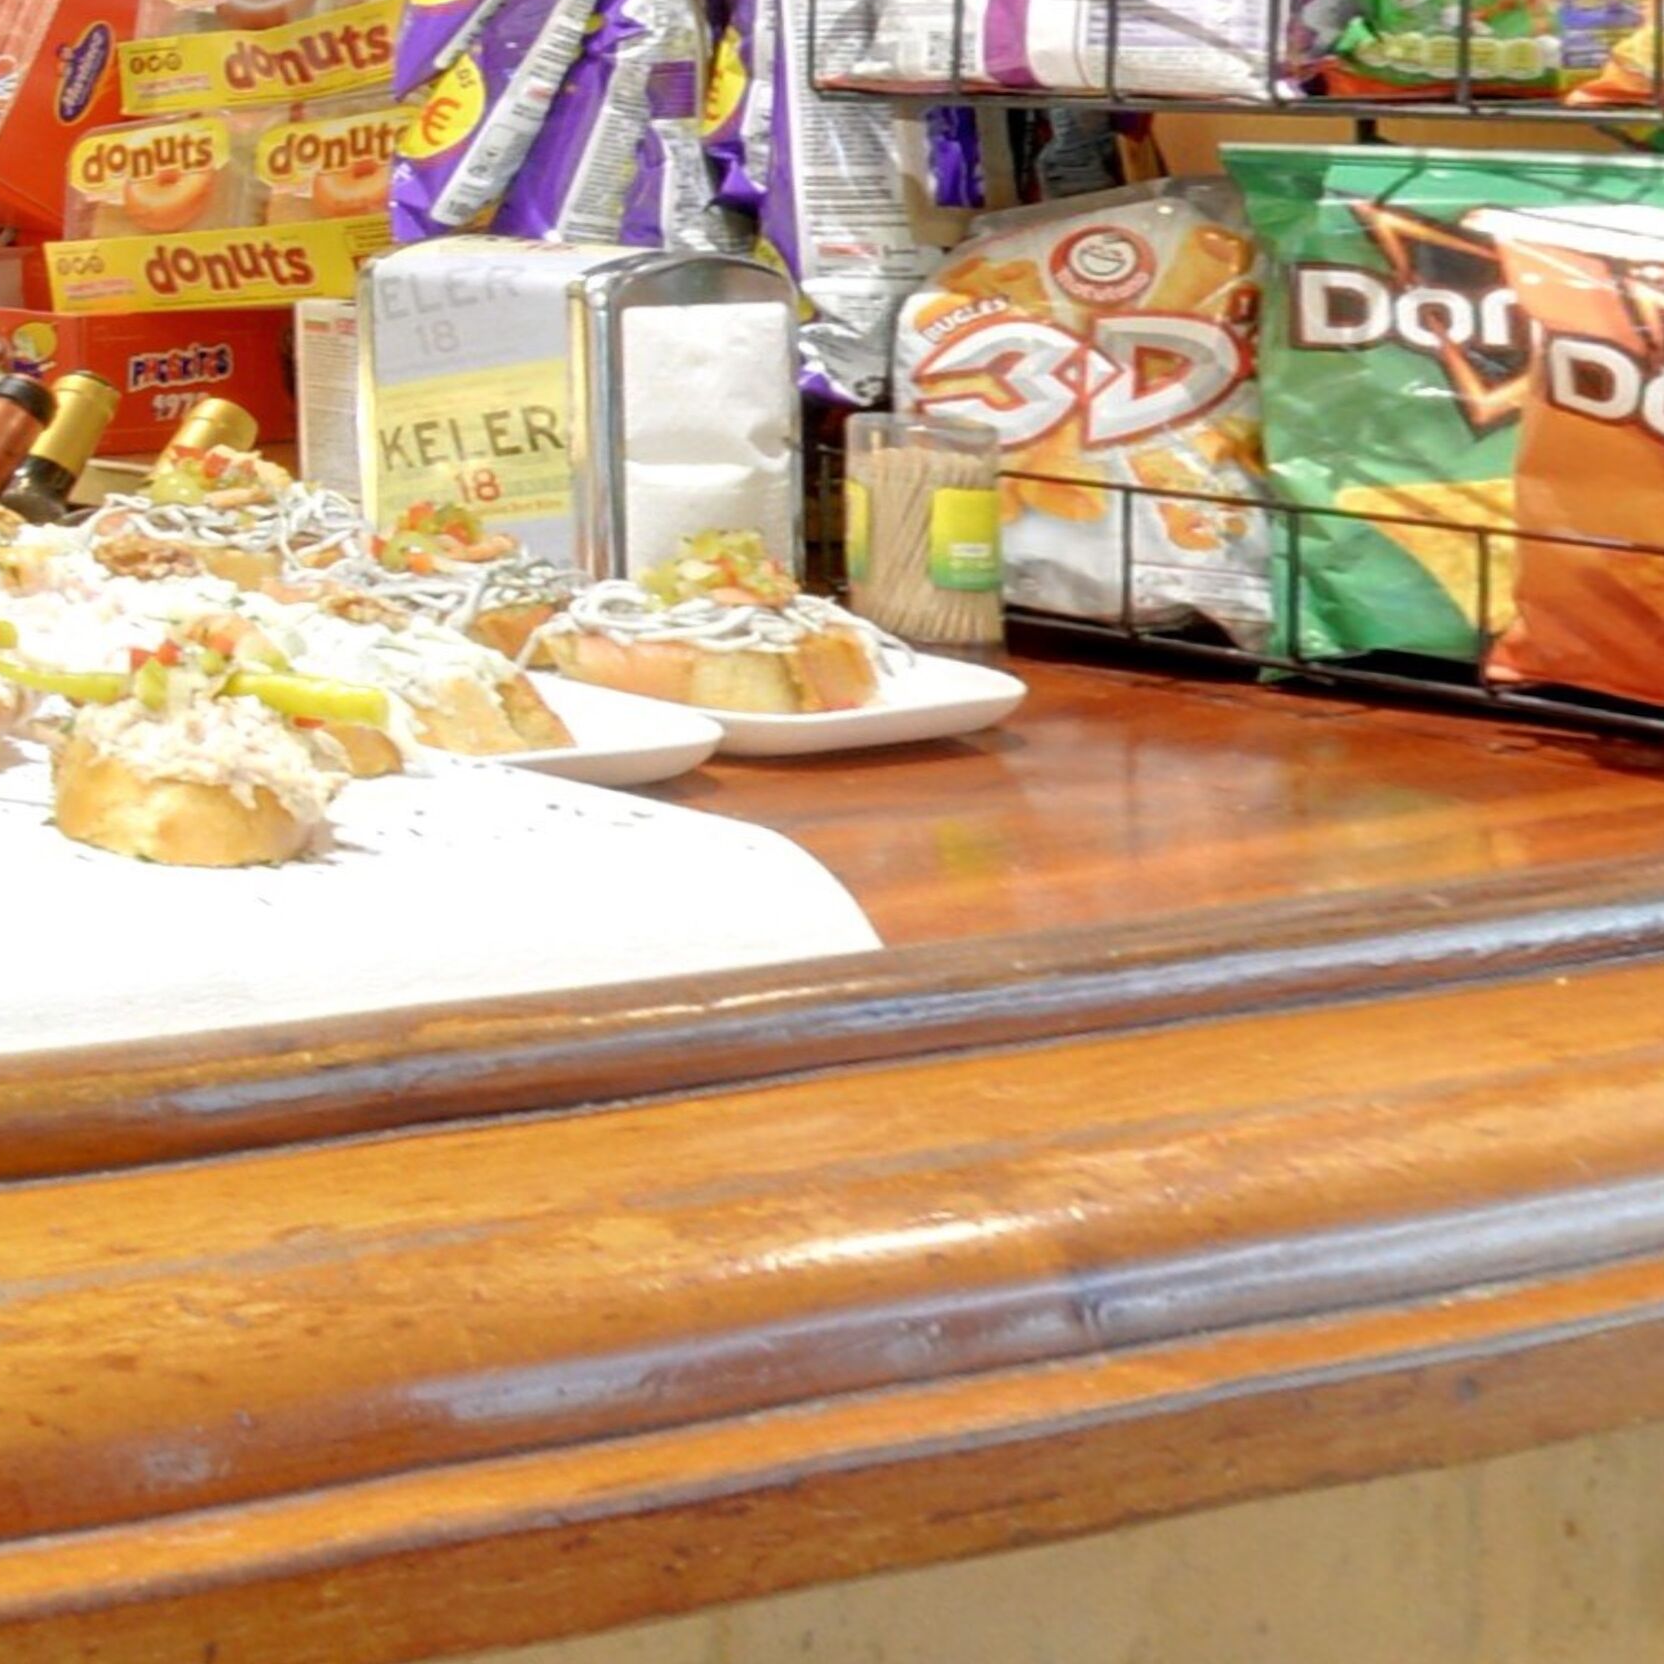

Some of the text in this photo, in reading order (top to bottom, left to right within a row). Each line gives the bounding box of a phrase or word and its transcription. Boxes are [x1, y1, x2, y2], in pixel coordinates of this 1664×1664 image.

[224, 22, 392, 91] donuts
[82, 135, 215, 184] donuts
[145, 242, 316, 295] donuts
[374, 265, 519, 323] ELER
[922, 296, 1008, 344] BUGLES
[379, 404, 565, 472] KELER
[455, 467, 502, 504] 18
